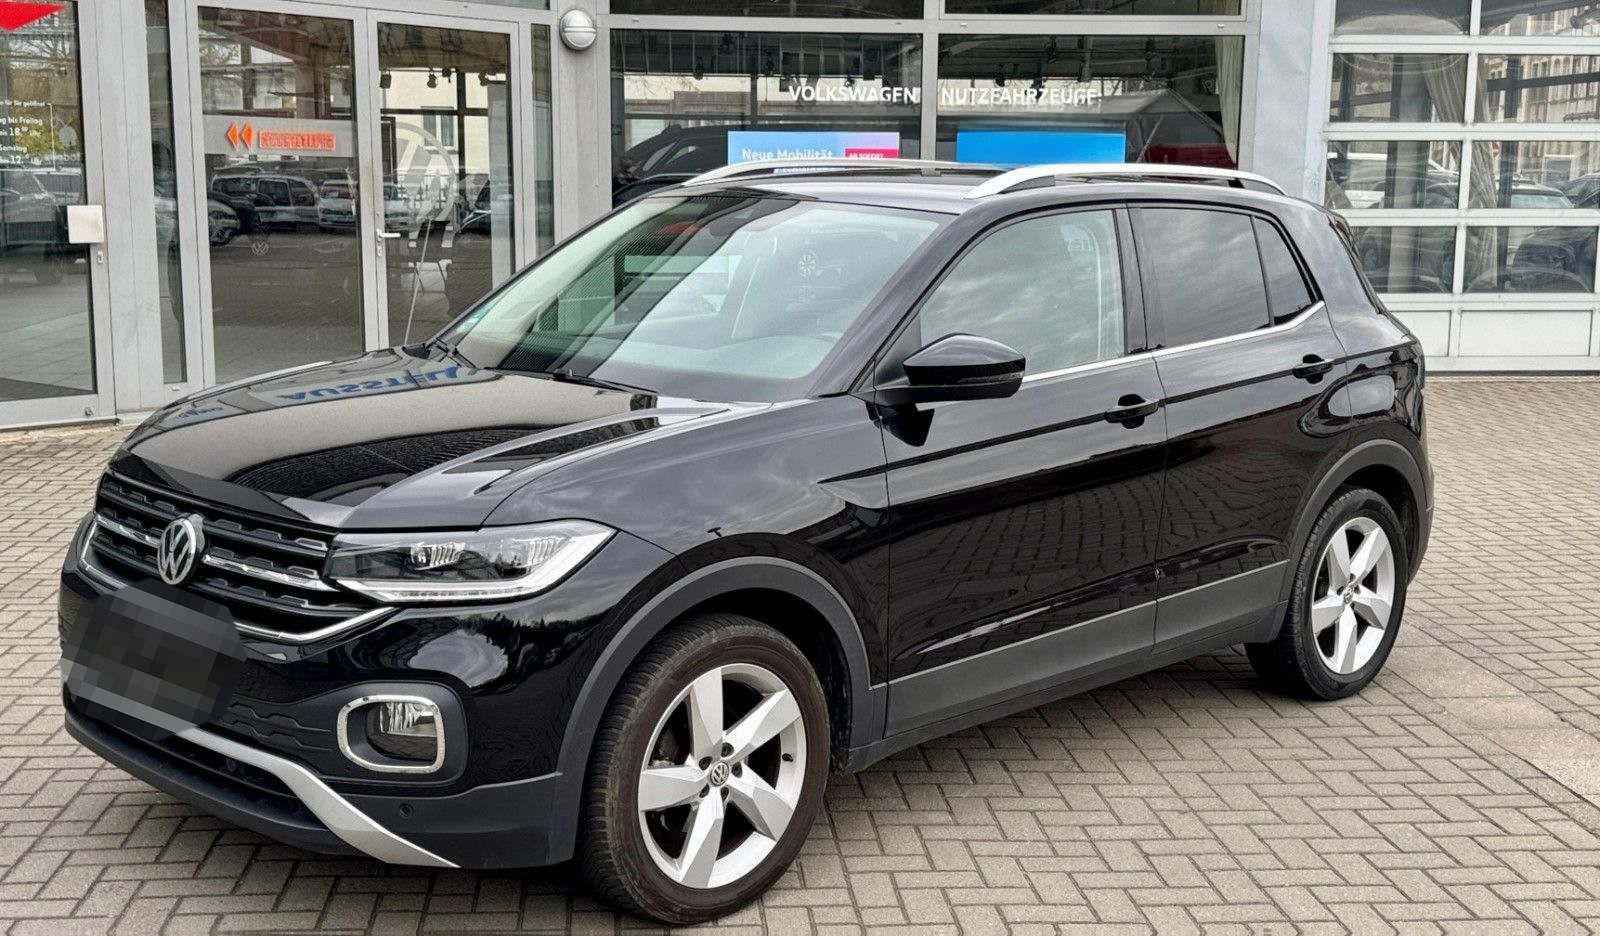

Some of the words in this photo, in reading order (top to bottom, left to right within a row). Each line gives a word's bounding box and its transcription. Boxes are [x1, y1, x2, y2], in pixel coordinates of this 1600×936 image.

[788, 84, 921, 104] VOLKSWAGEN
[941, 86, 1098, 106] NUTZFAHRZEUGE
[19, 116, 43, 126] Freitag
[742, 148, 774, 161] Neue
[776, 148, 833, 159] Mobilität
